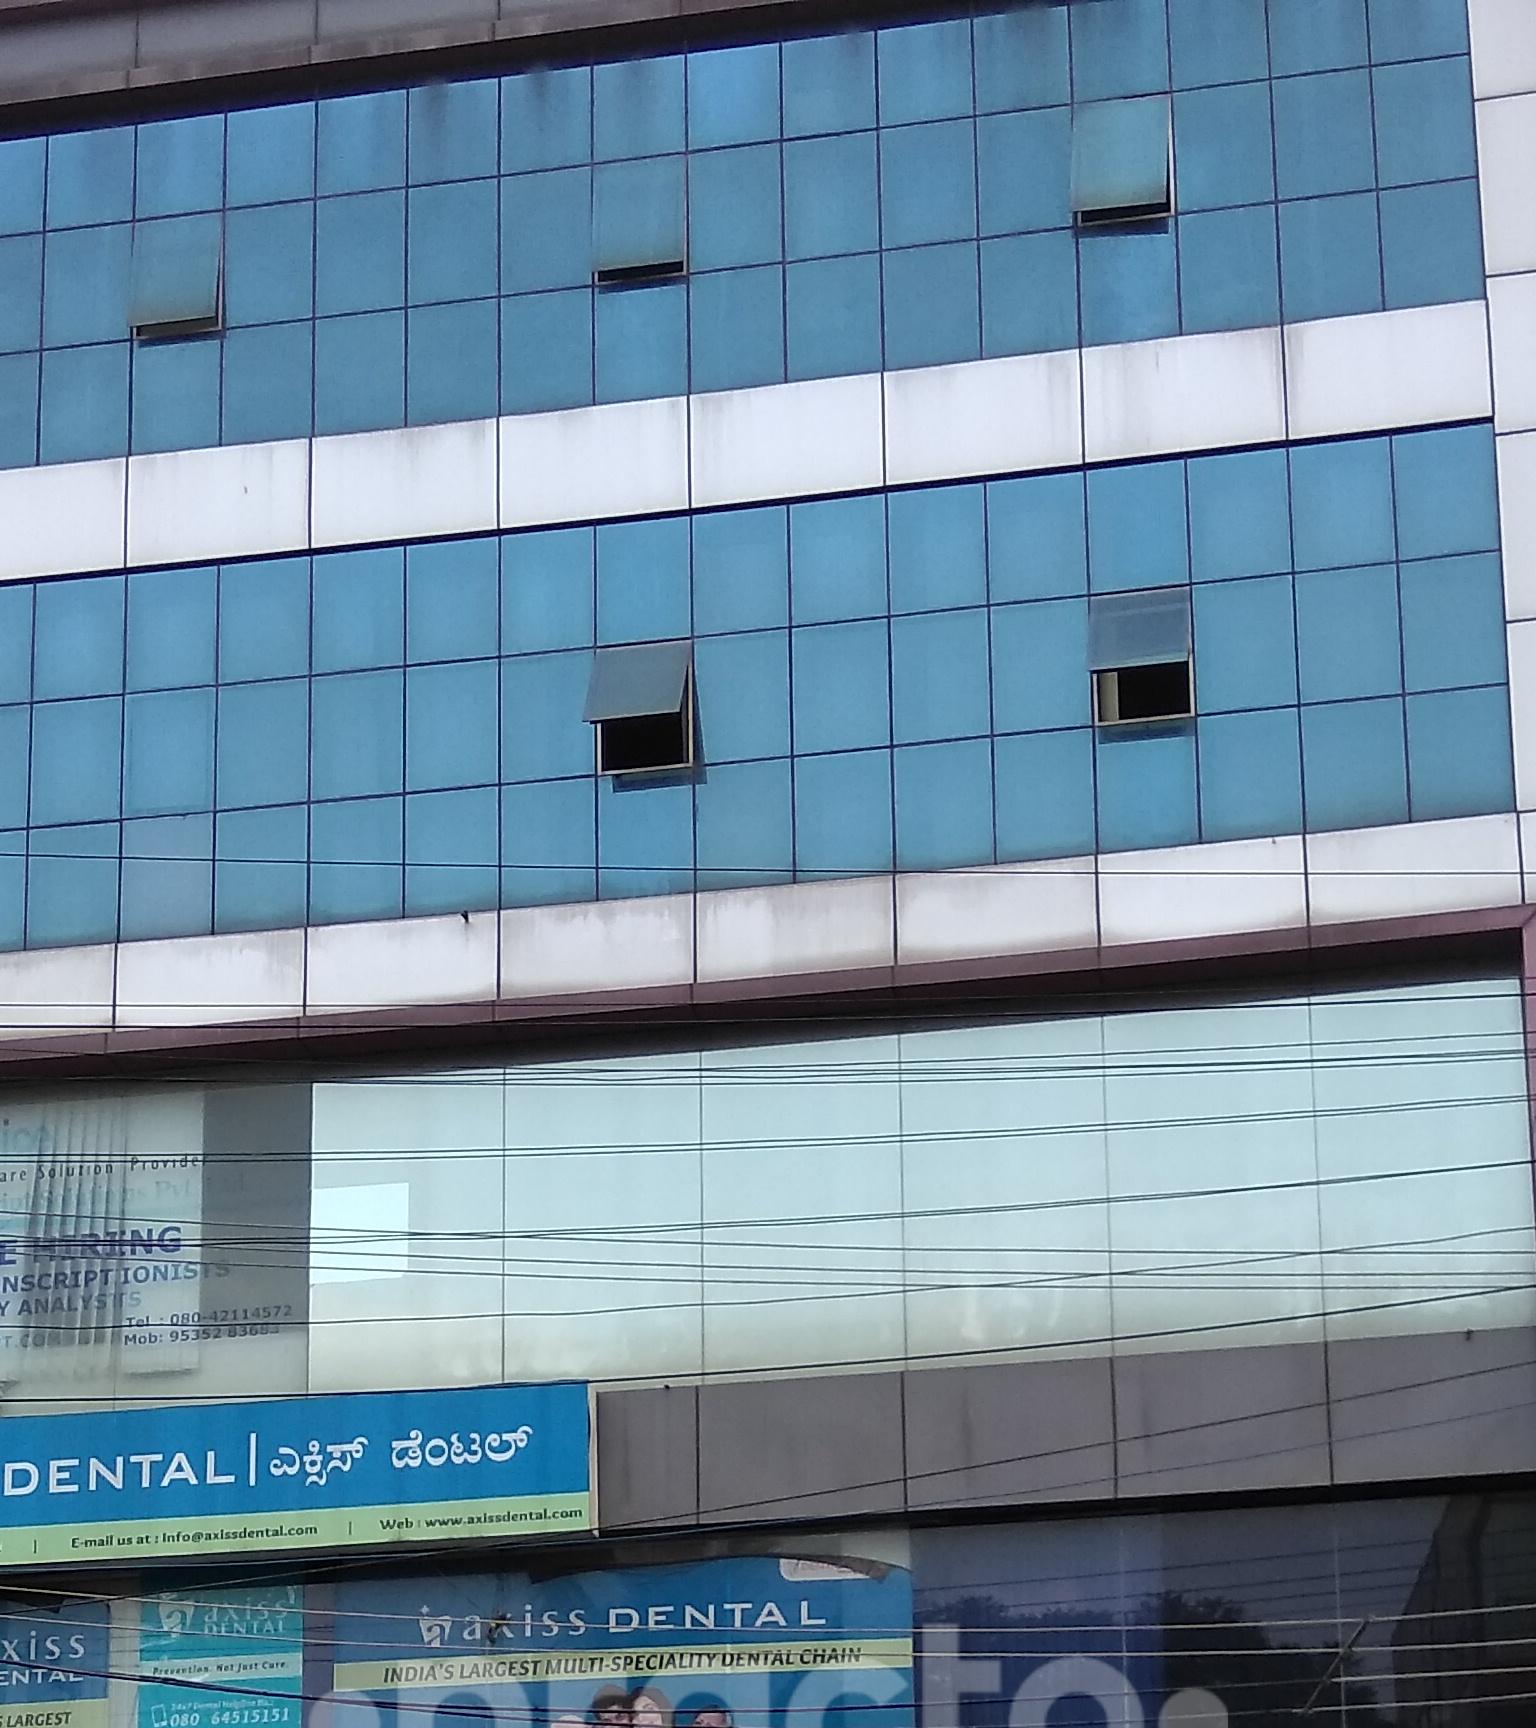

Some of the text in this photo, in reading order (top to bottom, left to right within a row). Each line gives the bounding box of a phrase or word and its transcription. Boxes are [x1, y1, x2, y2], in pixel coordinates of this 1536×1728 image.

[2, 1450, 236, 1497] DENTAL
[380, 1506, 583, 1531] Web www.axissdental.com
[71, 1536, 114, 1549] E-mail
[117, 1537, 133, 1547] us
[136, 1534, 151, 1545] at
[608, 1601, 826, 1634] DENTAL
[383, 1646, 862, 1685] INDIA'S LARGEST MULTI-SPECIALITY DENTAL CHAIN
[6, 1711, 72, 1728] LARGEST
[170, 1707, 290, 1727] 080 64515151
